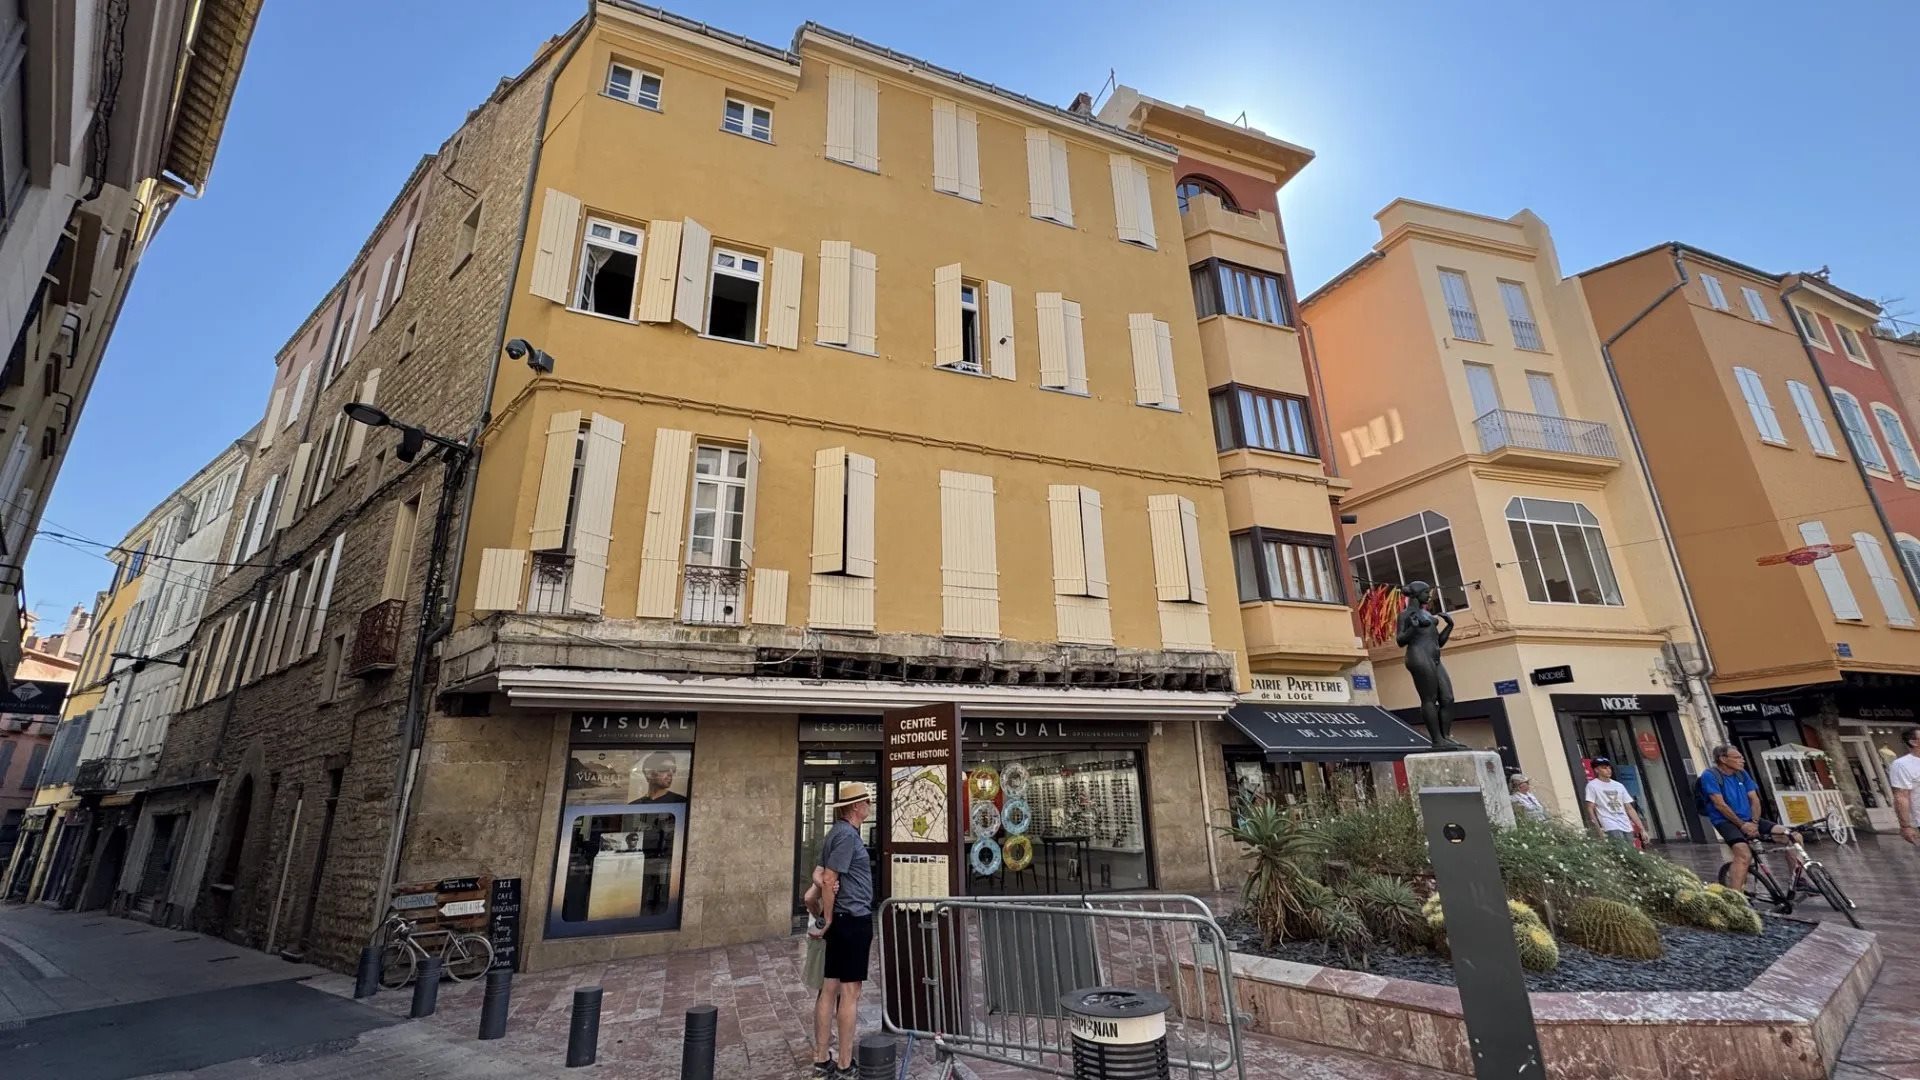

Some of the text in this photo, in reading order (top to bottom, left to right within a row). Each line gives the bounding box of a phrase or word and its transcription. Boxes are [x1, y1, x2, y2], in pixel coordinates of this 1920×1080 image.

[1261, 692, 1314, 701] de la LOGE
[1600, 694, 1641, 711] NOCIBÉ
[1742, 703, 1758, 713] TEA
[580, 716, 688, 732] VISUAL
[900, 716, 937, 730] CENTRE
[1263, 711, 1366, 725] PAPETERIE
[814, 723, 835, 732] LES
[961, 722, 1067, 739] VISUAL
[1297, 728, 1378, 738] DE LA LOGE
[890, 730, 948, 745] HISTORIQUE
[889, 748, 950, 761] CENTRE HISTORIC
